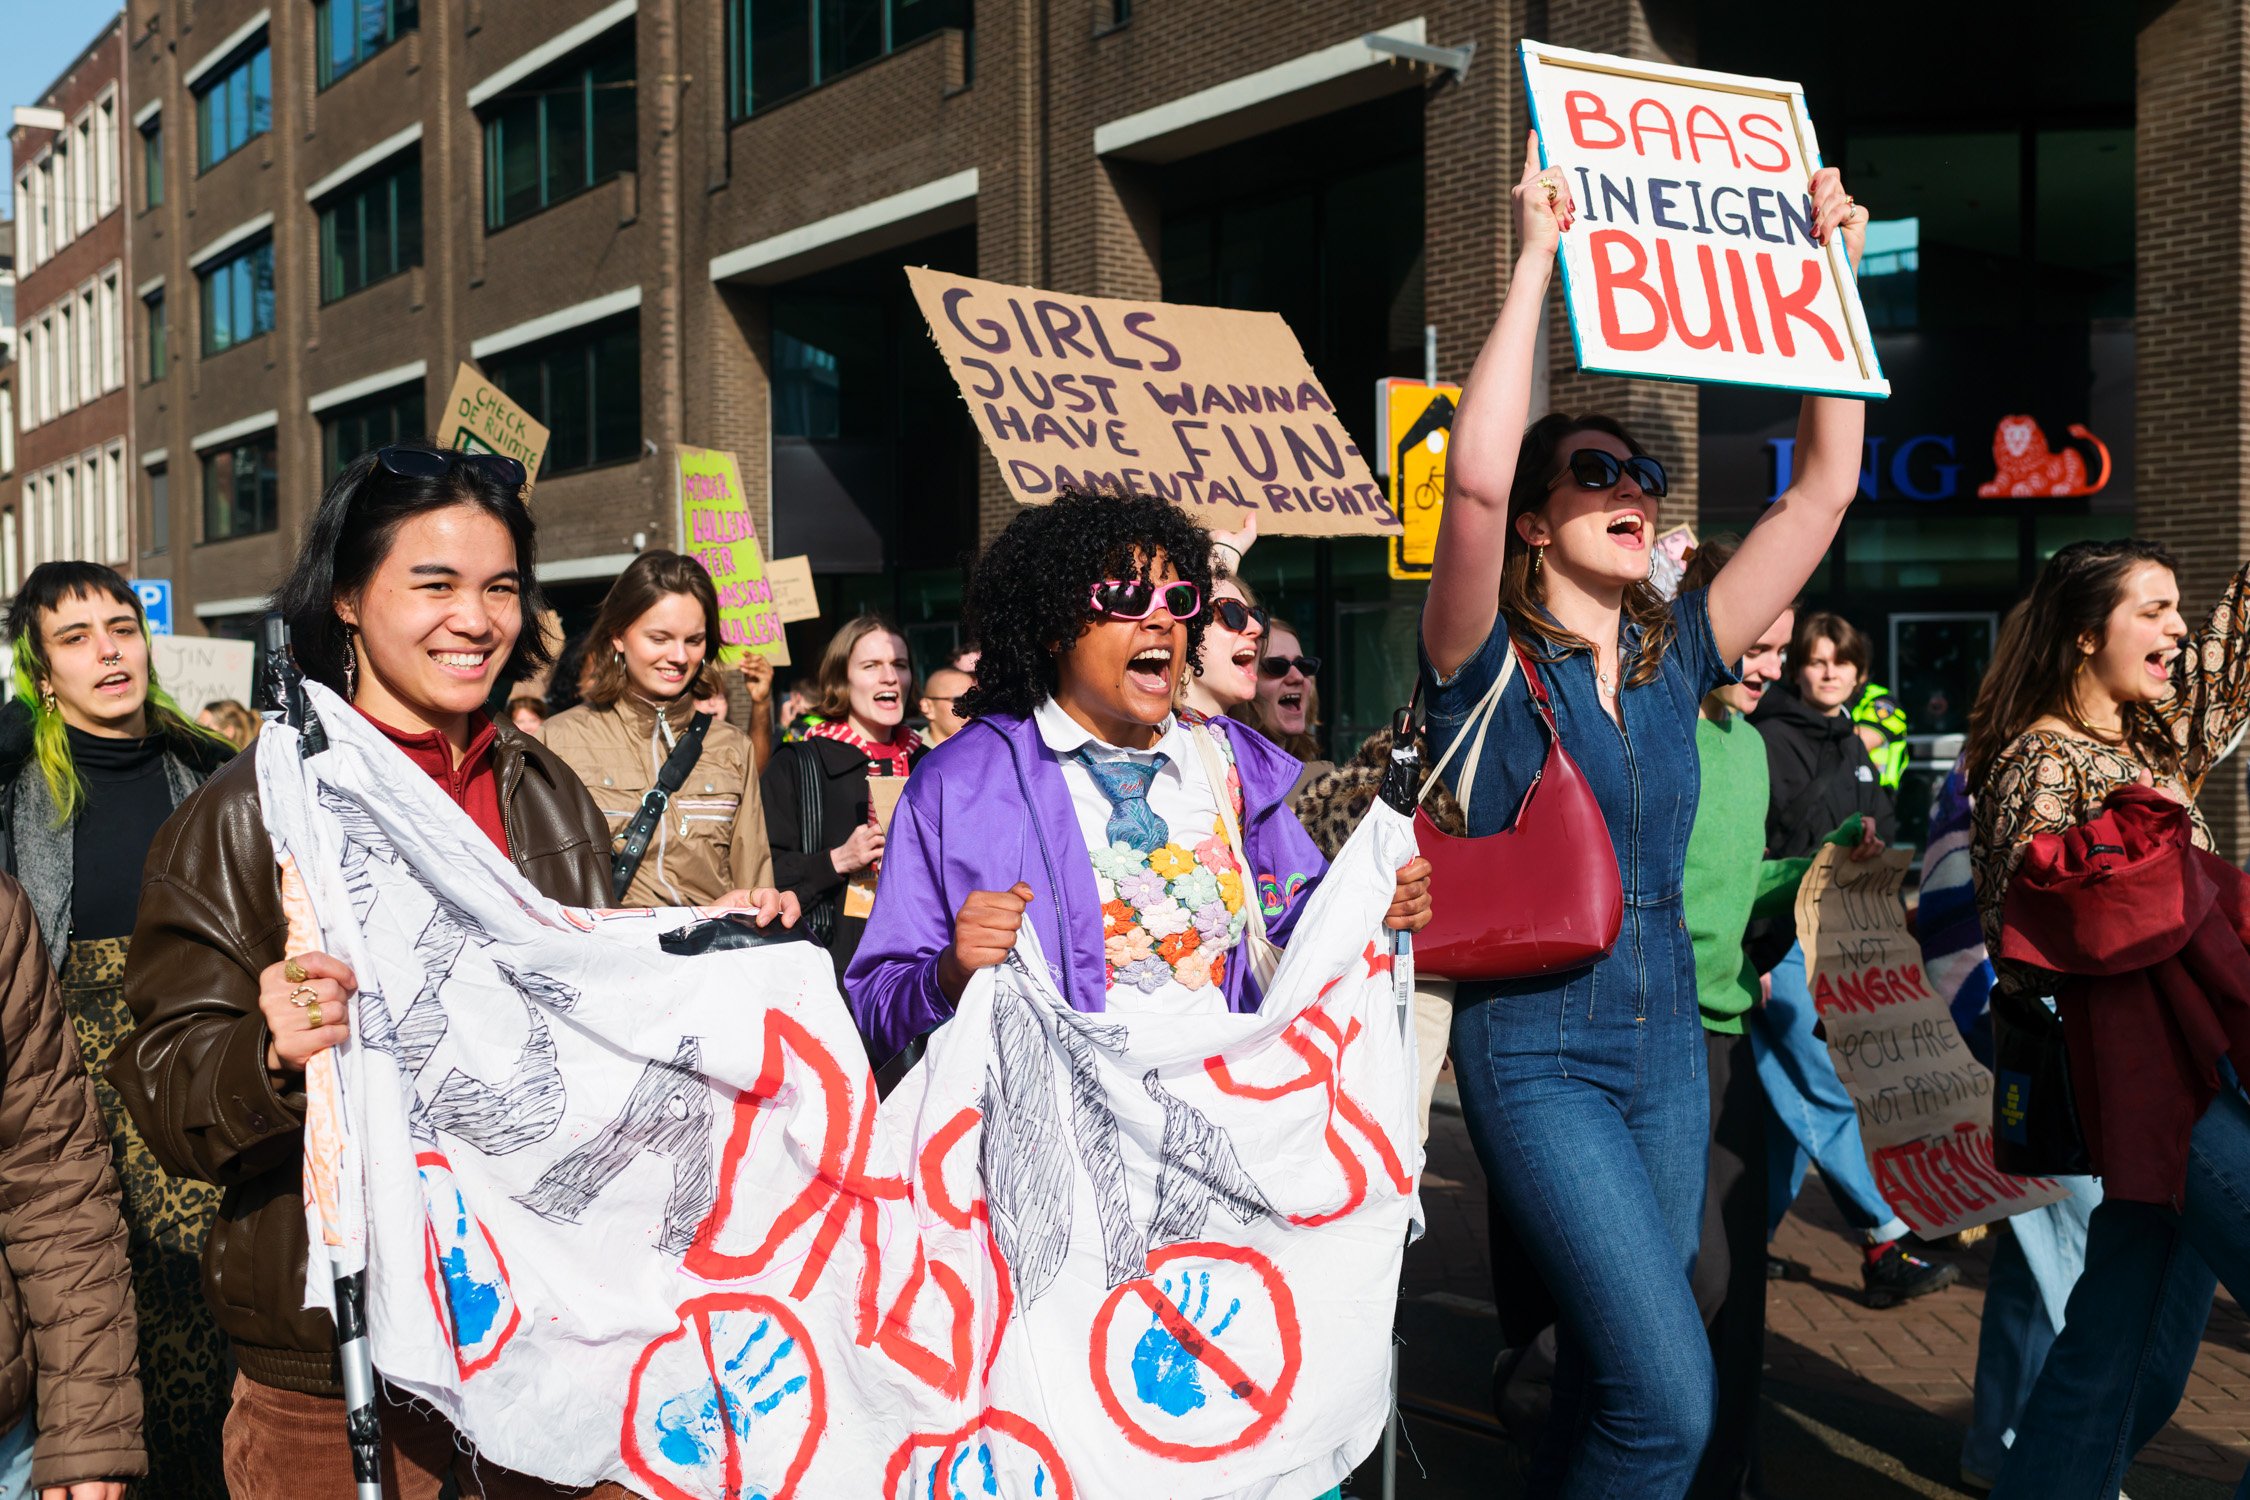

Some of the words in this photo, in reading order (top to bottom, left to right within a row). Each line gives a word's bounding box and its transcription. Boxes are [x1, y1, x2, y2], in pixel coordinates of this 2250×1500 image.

[1565, 90, 1791, 173] BAAS
[1574, 166, 1639, 225] IN
[1648, 178, 1819, 250] EIGEN
[1590, 229, 1845, 362] BUIK
[942, 287, 1182, 372] GIRLS
[476, 386, 527, 440] CHECK
[961, 356, 1120, 416] JUST
[1143, 378, 1335, 416] WANNA
[458, 397, 479, 426] DE
[484, 416, 538, 471] RUIMTE
[984, 402, 1140, 457] HAVE
[1171, 420, 1361, 483] FUN-
[685, 472, 732, 501] MINDER
[1008, 460, 1260, 510] DAMENTAL
[1261, 482, 1400, 527] RIGHTS
[692, 507, 754, 544] LULLEN
[139, 586, 162, 615] P
[164, 644, 217, 682] JIN
[1805, 864, 1834, 935] IF
[1837, 937, 1891, 969] NOT
[1814, 963, 1930, 1016] ANGRY
[1834, 1029, 1904, 1073] YOU
[1911, 1018, 1960, 1060] ARE
[1855, 1086, 1903, 1128] NOT
[1902, 1062, 1992, 1117] PAYING
[1871, 1120, 2060, 1233] ATTENTI
